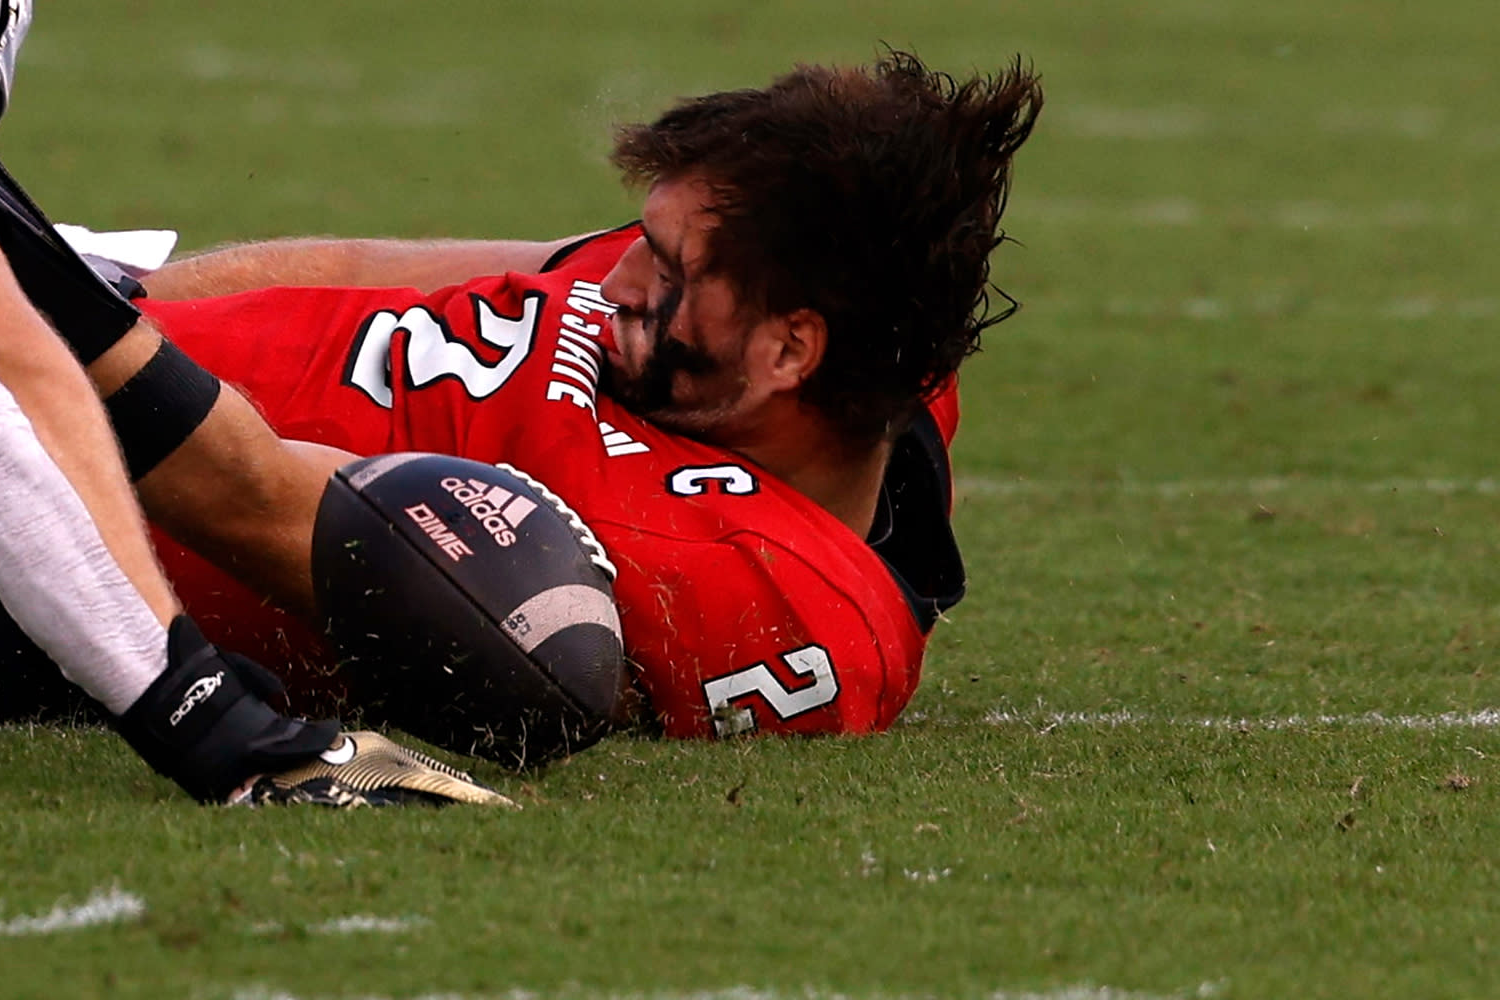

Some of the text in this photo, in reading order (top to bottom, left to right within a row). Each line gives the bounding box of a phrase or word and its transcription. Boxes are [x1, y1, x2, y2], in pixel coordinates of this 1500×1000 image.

[664, 462, 758, 497] C
[404, 502, 475, 562] DIME
[440, 477, 517, 548] adidas
[703, 643, 841, 740] 2
